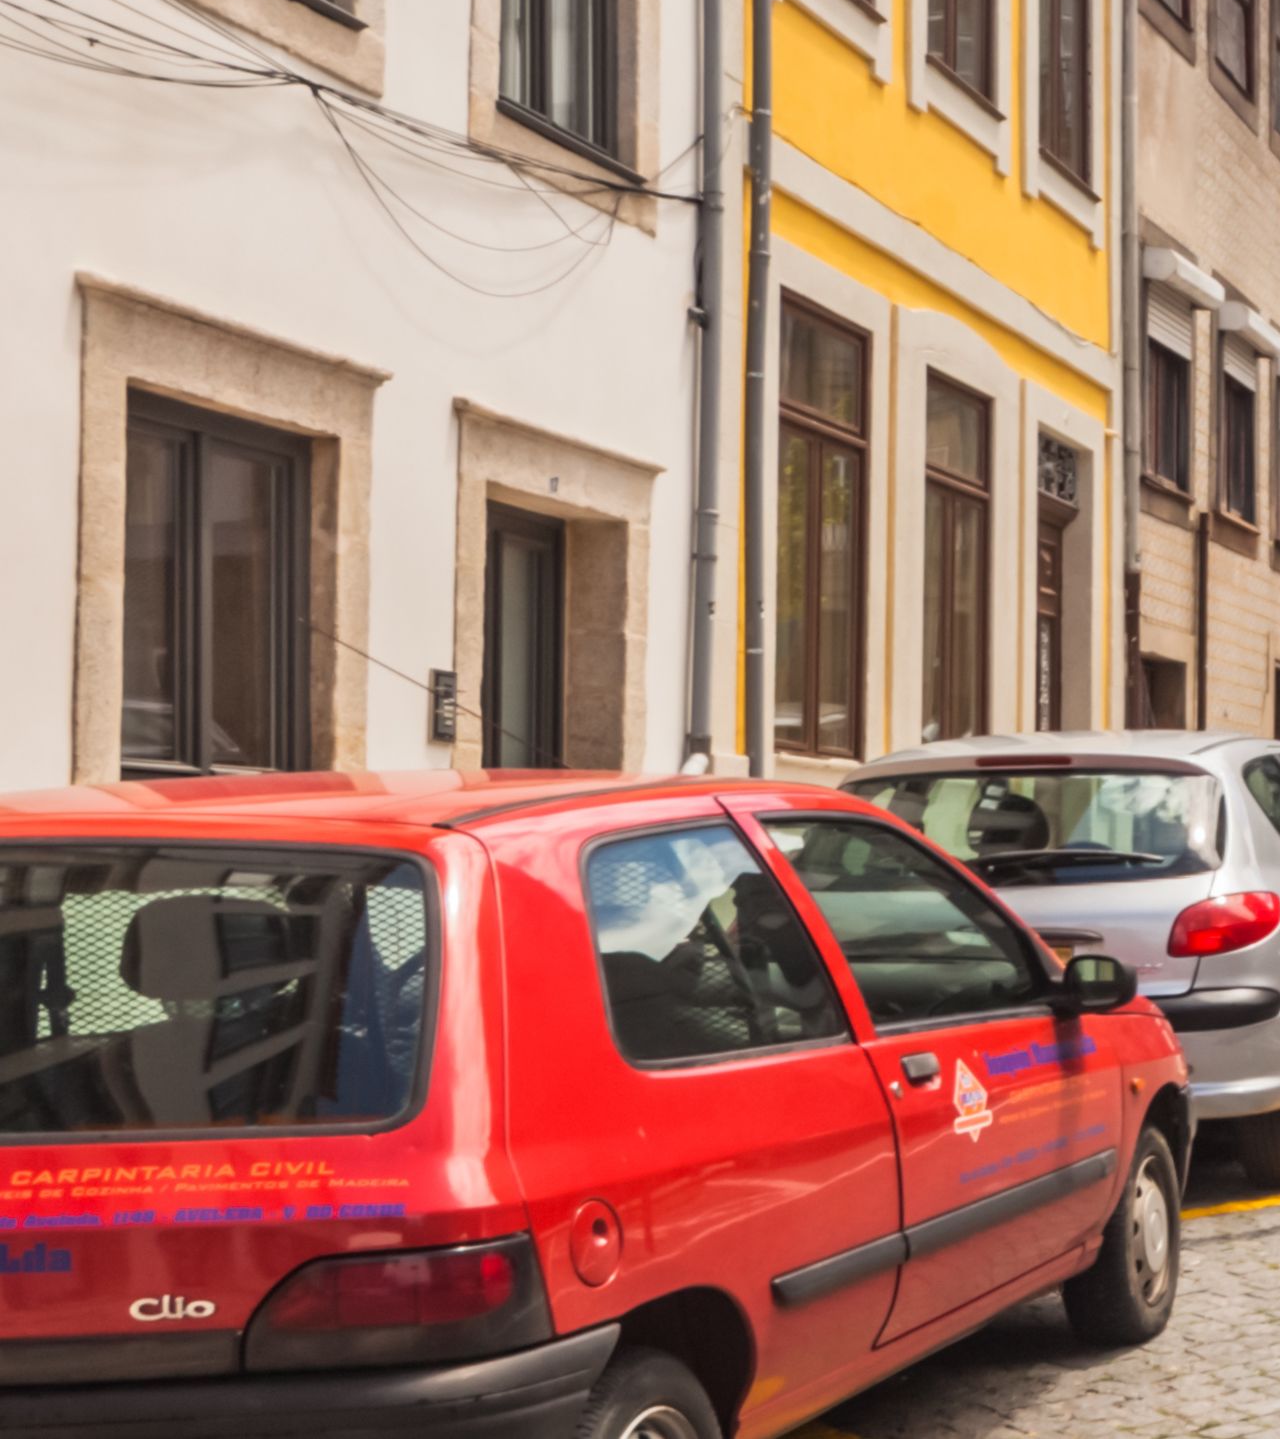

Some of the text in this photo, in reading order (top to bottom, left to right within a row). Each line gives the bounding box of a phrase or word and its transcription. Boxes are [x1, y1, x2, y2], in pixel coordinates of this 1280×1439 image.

[10, 1162, 335, 1186] CARPINTARIA CIVIL
[129, 1293, 217, 1322] Clio
